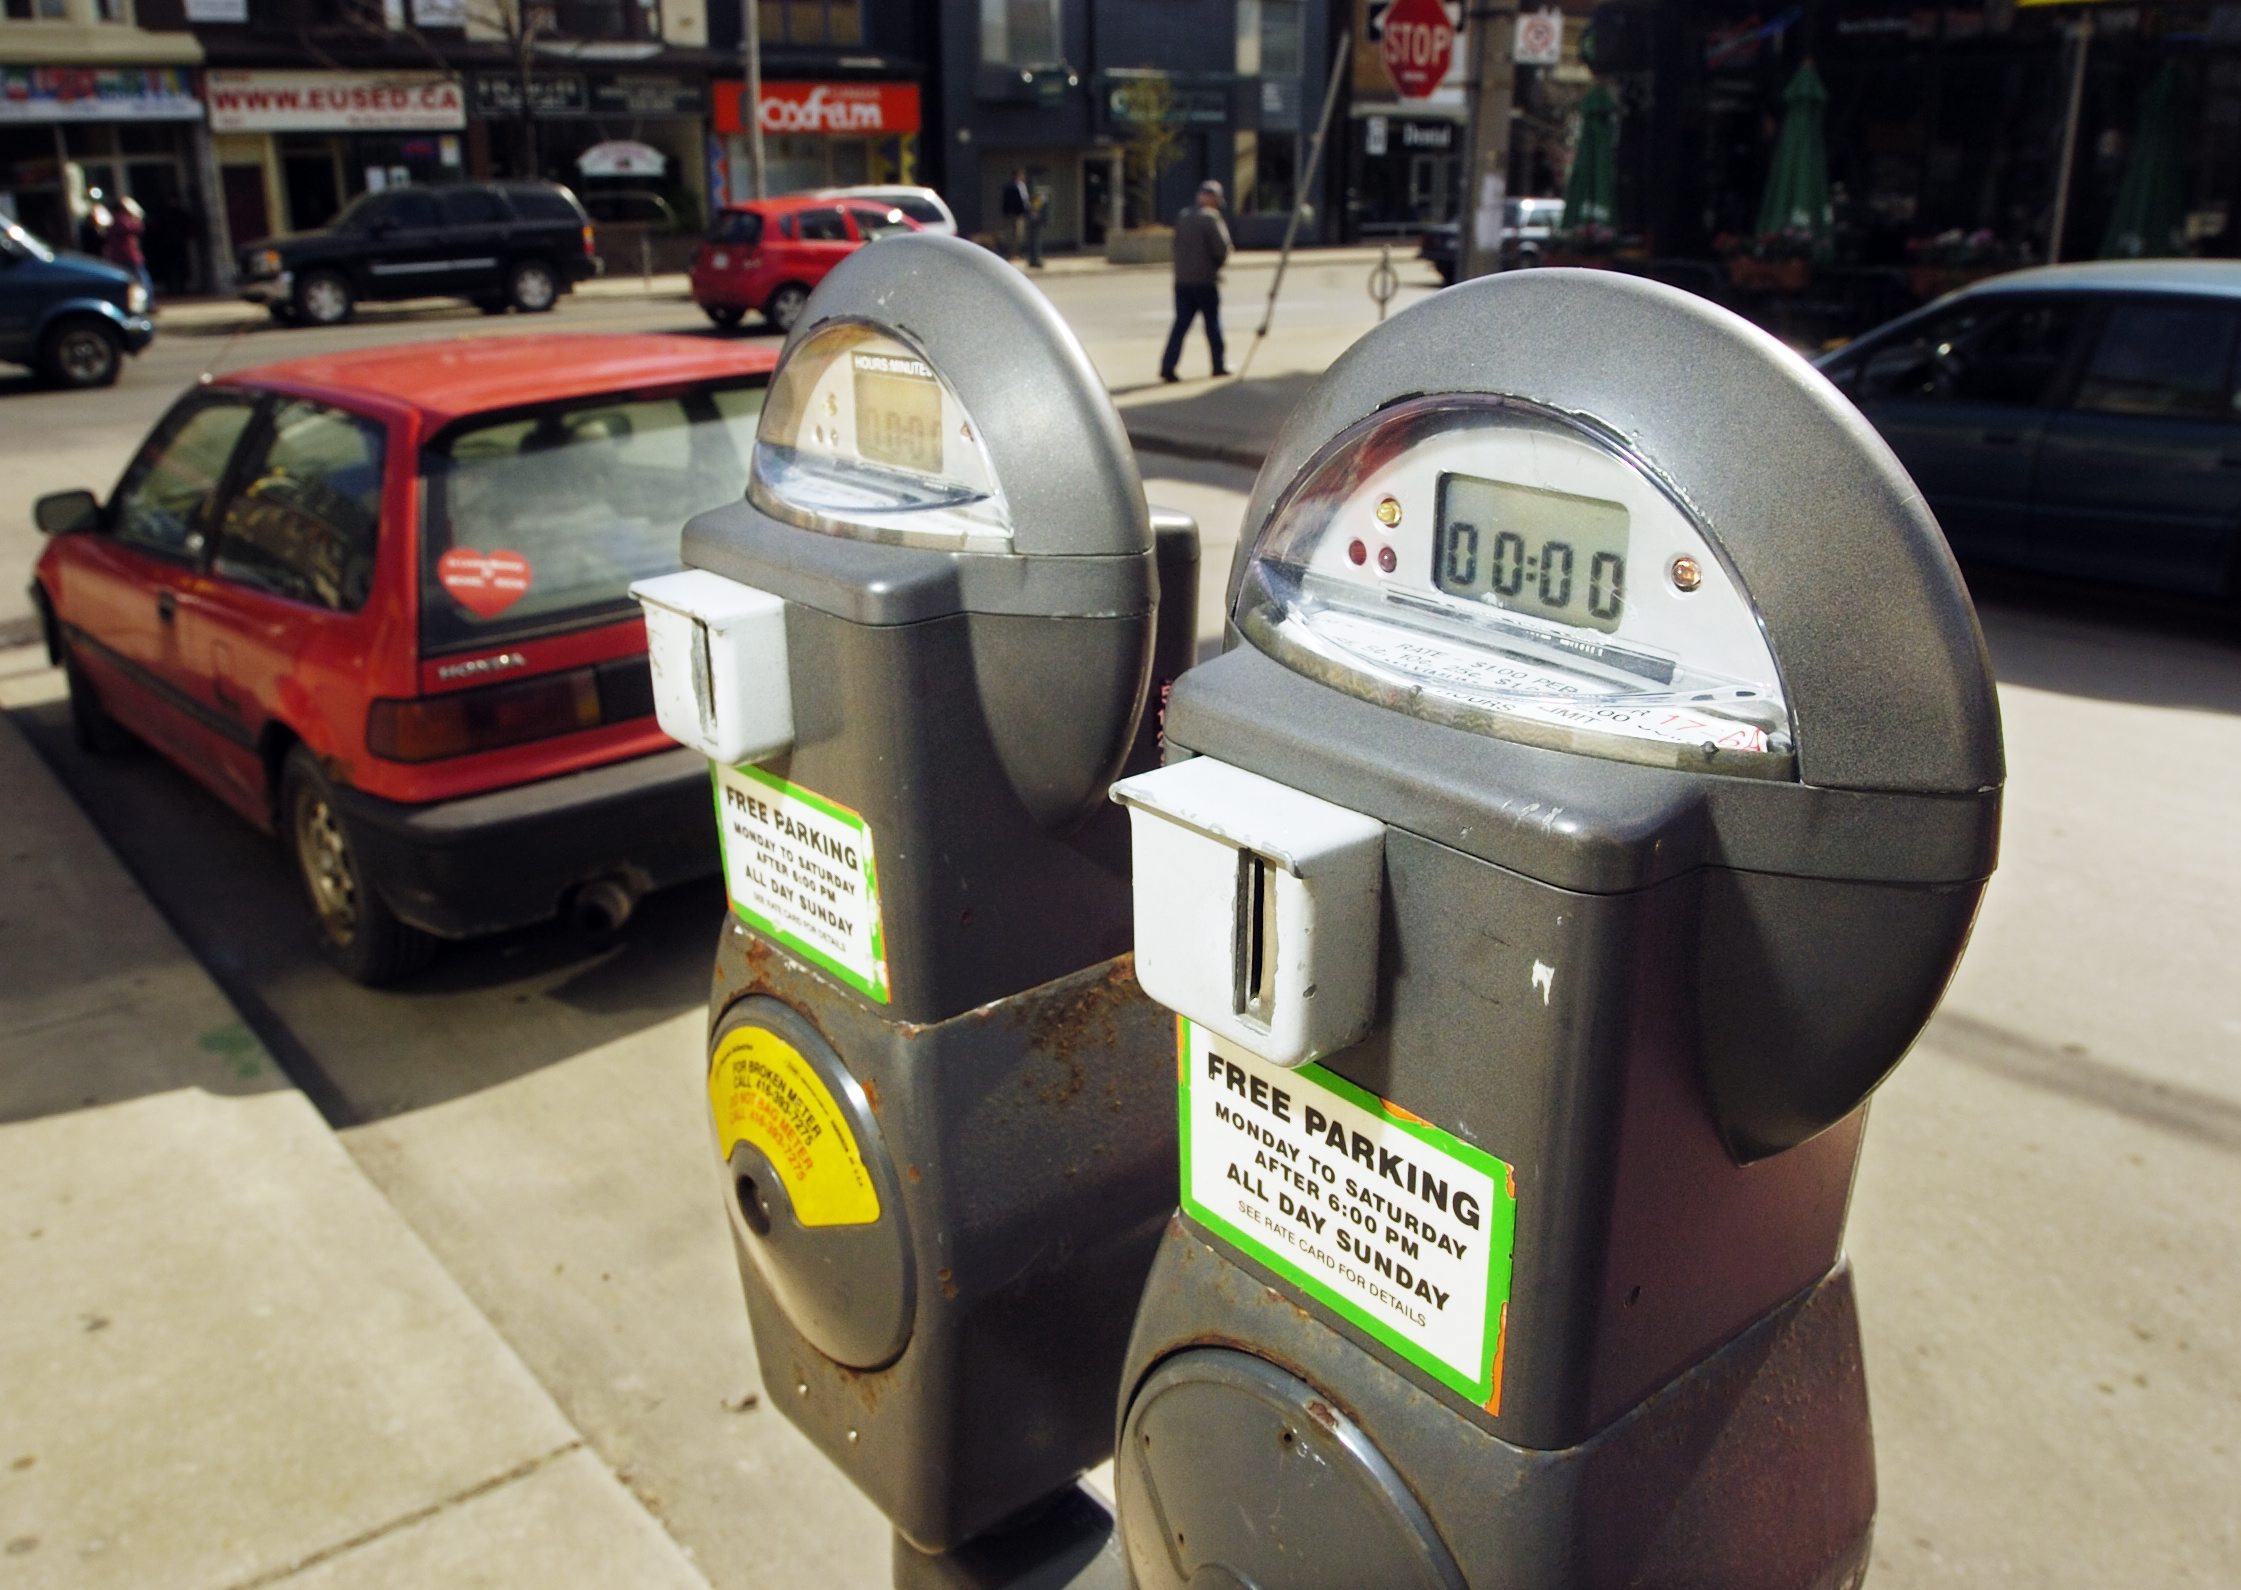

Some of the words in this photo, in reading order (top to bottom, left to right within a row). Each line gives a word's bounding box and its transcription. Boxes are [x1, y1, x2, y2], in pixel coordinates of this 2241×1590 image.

[1386, 23, 1450, 66] STOP
[215, 87, 459, 111] WWW.EUSED.CA
[1447, 521, 1627, 620] 00:00
[1532, 678, 1578, 693] PER
[726, 785, 768, 824] FREE
[774, 808, 858, 871] PARKING
[734, 822, 775, 853] MONDAY
[780, 846, 793, 862] TO
[798, 856, 855, 895] SATURDAY
[745, 865, 766, 887] ALL
[771, 877, 794, 901] DAY
[799, 895, 853, 936] SUNDAY
[756, 851, 788, 875] AFTER
[793, 869, 815, 892] 6:00
[820, 886, 836, 902] PM
[749, 1060, 787, 1092] BROKEN
[788, 1088, 822, 1138] METER
[779, 1118, 814, 1170] METER
[1208, 1052, 1291, 1124] FREE
[1305, 1105, 1481, 1231] PARKING
[1215, 1101, 1300, 1162] MONDAY
[1308, 1155, 1336, 1185] TO
[1345, 1178, 1468, 1261] SATURDAY
[1255, 1150, 1320, 1200] AFTER
[1329, 1195, 1377, 1234] 6:00
[1385, 1227, 1419, 1261] PM
[1227, 1162, 1269, 1203] ALL
[1279, 1191, 1326, 1235] DAY
[1336, 1228, 1451, 1312] SUNDAY
[1238, 1199, 1262, 1224] SEE
[1265, 1213, 1296, 1246] RATE
[1299, 1238, 1336, 1269] CARD
[1338, 1263, 1366, 1290] FOR
[1369, 1282, 1427, 1328] DETAILS
